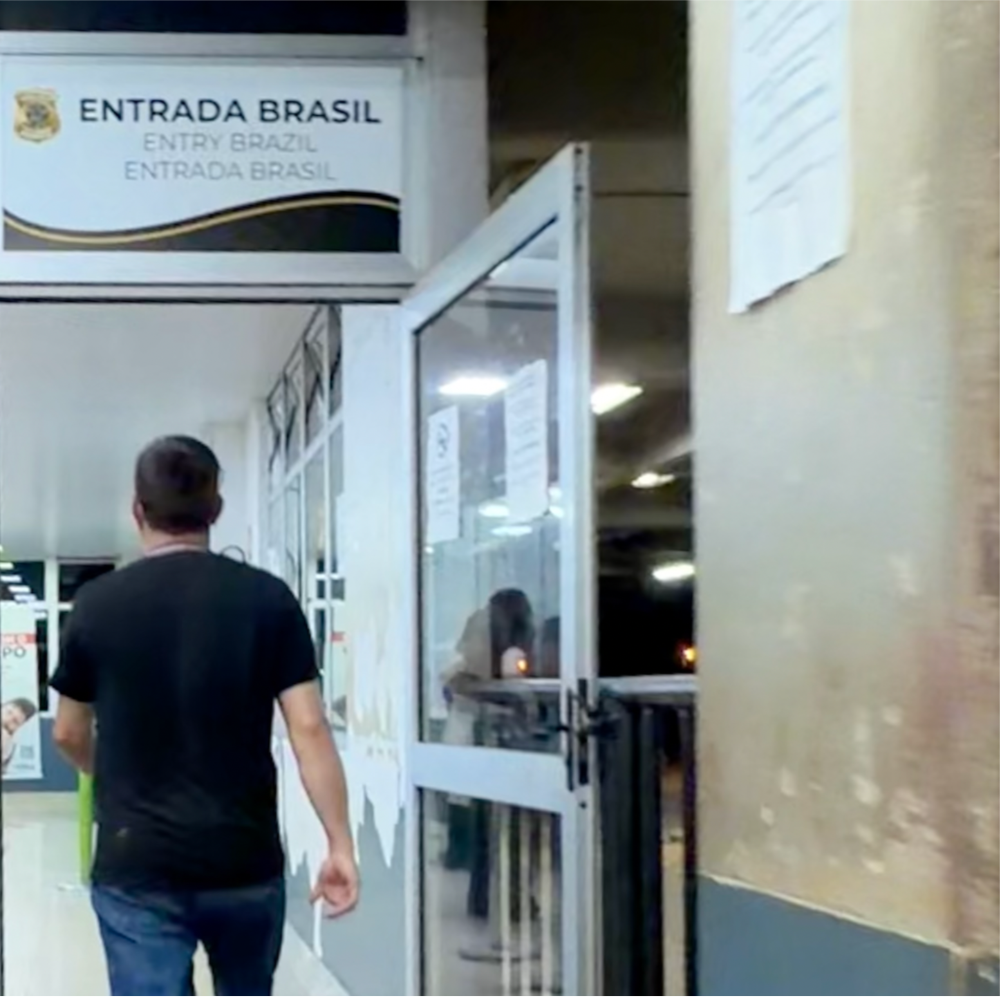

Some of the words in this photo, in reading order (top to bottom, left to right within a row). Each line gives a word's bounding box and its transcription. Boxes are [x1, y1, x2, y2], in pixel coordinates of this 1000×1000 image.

[80, 98, 246, 123] ENTRADA
[260, 99, 382, 124] BRASIL
[143, 133, 224, 152] ENTRY
[230, 133, 318, 153] BRAZIL
[125, 161, 243, 181] ENTRADA
[250, 161, 338, 181] BRASIL
